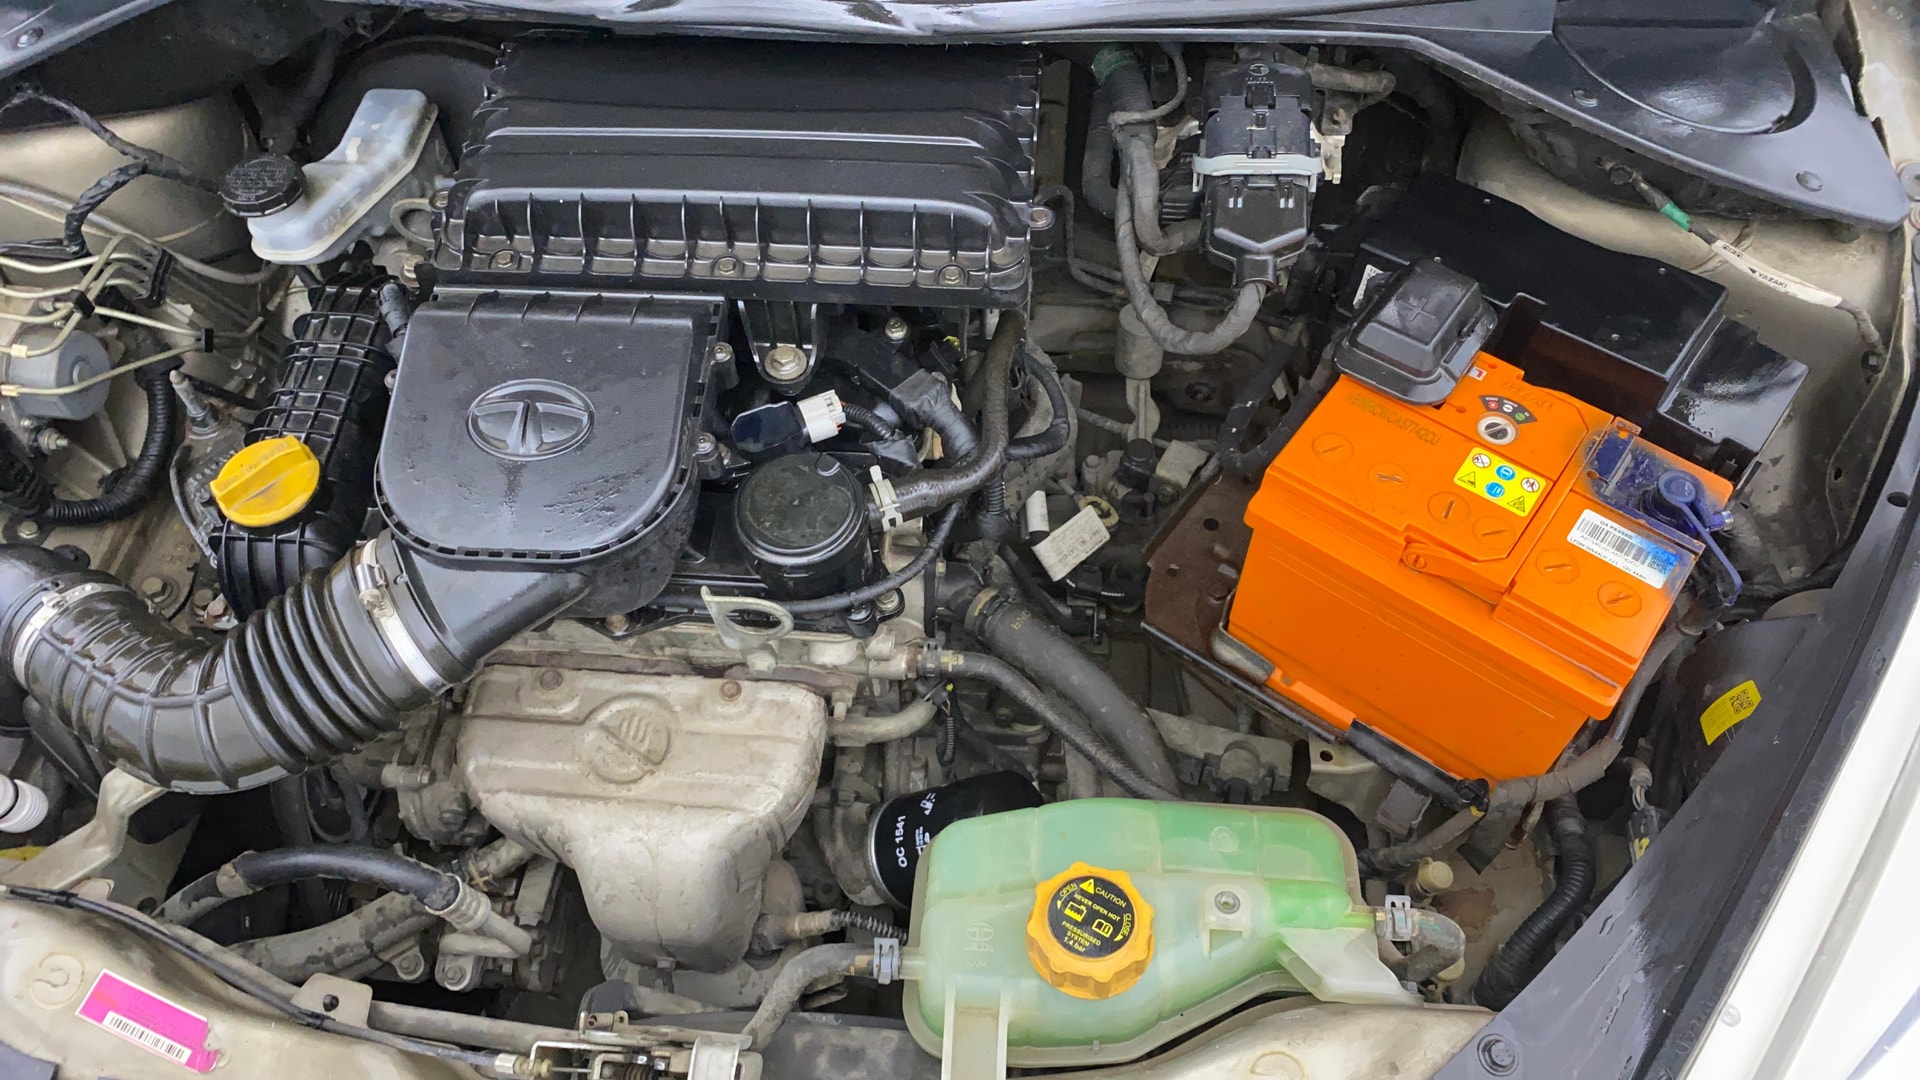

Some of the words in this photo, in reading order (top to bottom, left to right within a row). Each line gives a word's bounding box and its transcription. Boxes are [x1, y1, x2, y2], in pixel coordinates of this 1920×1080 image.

[1758, 271, 1789, 289] YAZAKI
[894, 815, 906, 844] 1541
[895, 846, 908, 868] OC
[1060, 882, 1078, 897] OPEN
[1095, 887, 1127, 908] CAUTION
[1073, 893, 1093, 907] NEVER
[1092, 903, 1108, 916] OPEN
[1107, 911, 1121, 922] HOT
[1061, 920, 1101, 946] PRESSURISED
[1122, 913, 1132, 937] CLOSE
[1064, 936, 1074, 946] 1.4
[1073, 941, 1086, 953] bar
[1066, 930, 1090, 947] SYSTEM
